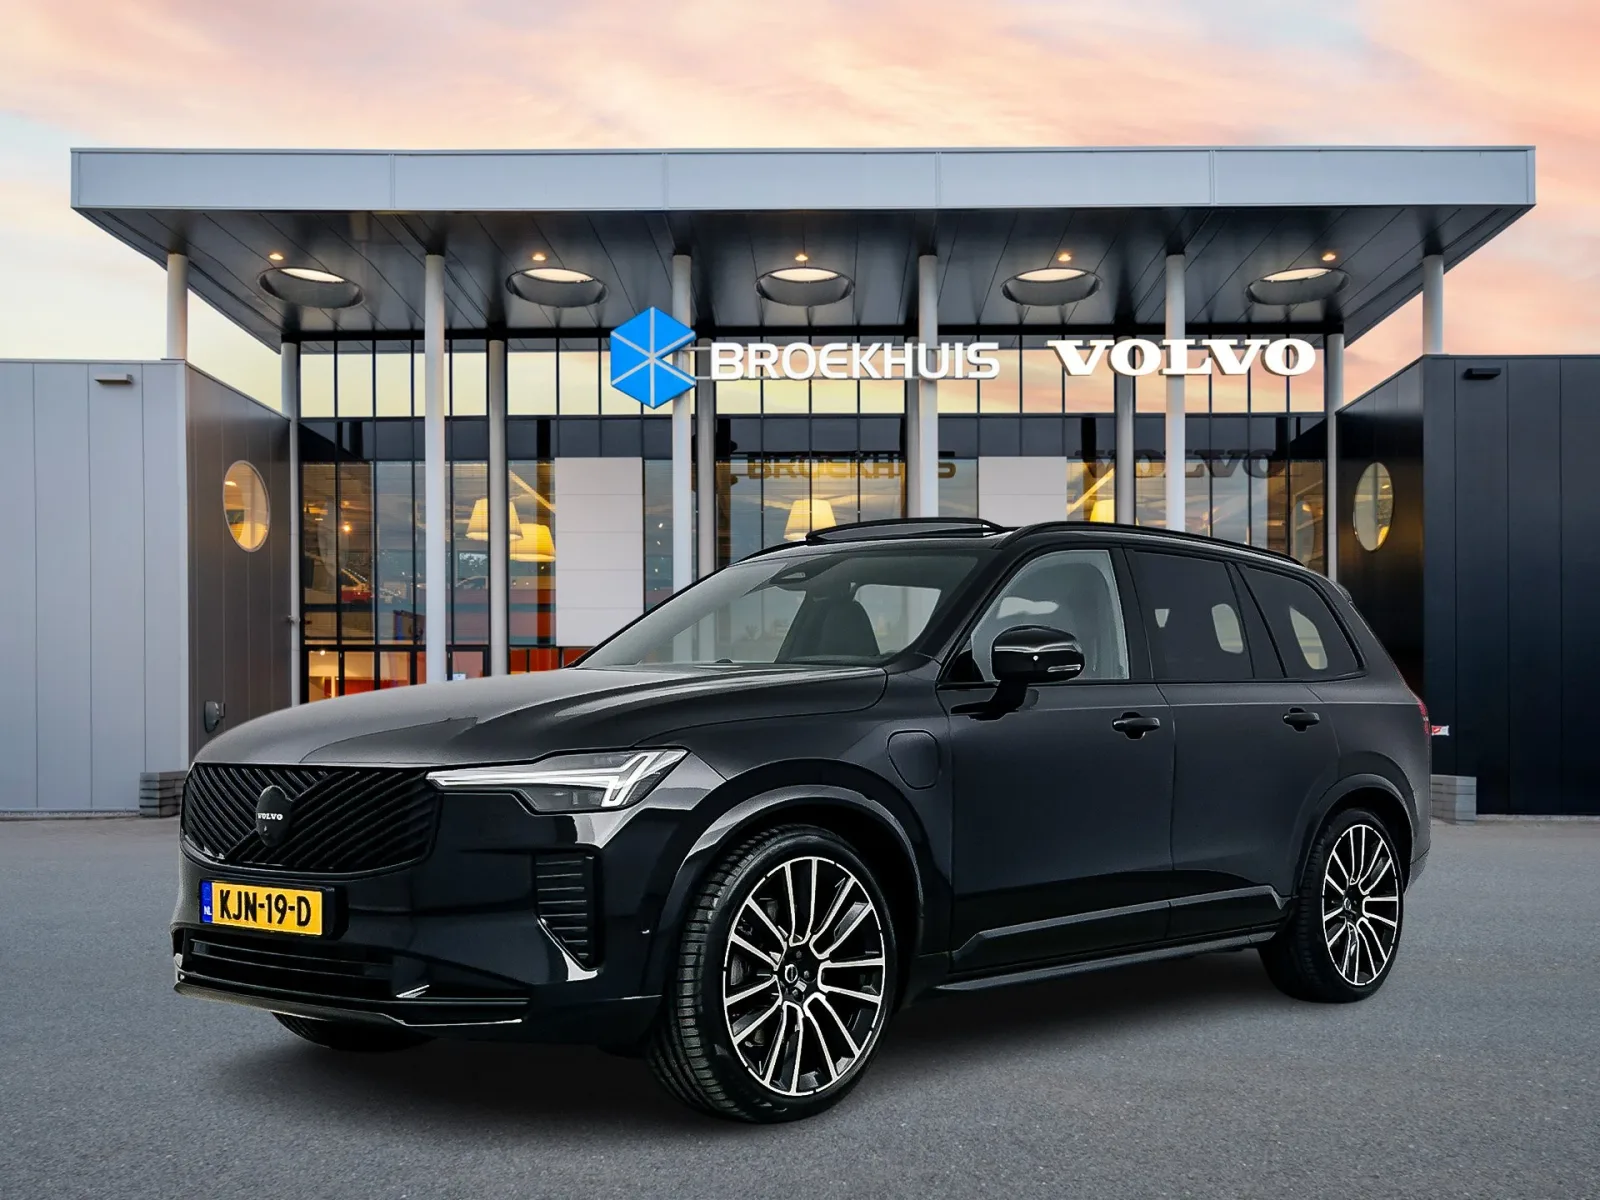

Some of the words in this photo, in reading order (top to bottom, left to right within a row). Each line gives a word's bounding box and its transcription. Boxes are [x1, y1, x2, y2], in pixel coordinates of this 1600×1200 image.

[710, 342, 1000, 380] BROEKHUIS
[1045, 338, 1316, 376] VOLVO
[747, 454, 956, 479] BROEKHS
[257, 812, 283, 820] VOLVO
[203, 905, 212, 915] NL
[220, 889, 311, 927] KJN-19-D
